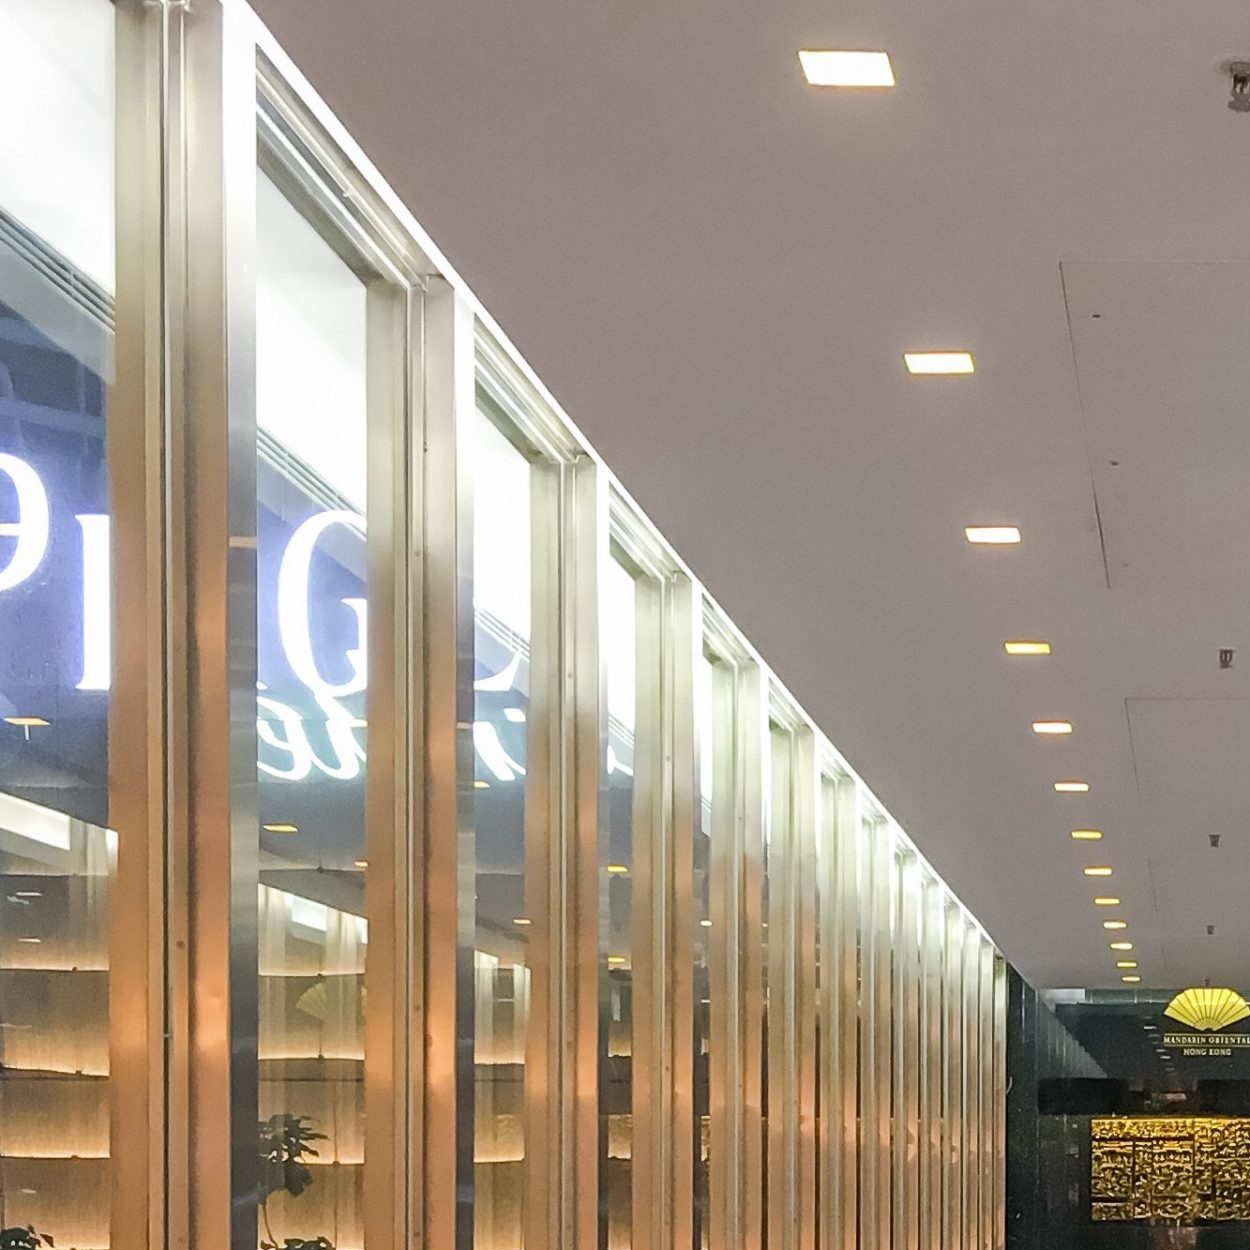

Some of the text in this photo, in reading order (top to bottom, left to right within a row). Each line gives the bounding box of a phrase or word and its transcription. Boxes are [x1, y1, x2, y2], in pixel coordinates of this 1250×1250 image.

[1163, 1036, 1207, 1044] MANDARIN
[1183, 1048, 1232, 1056] HONG KONG
